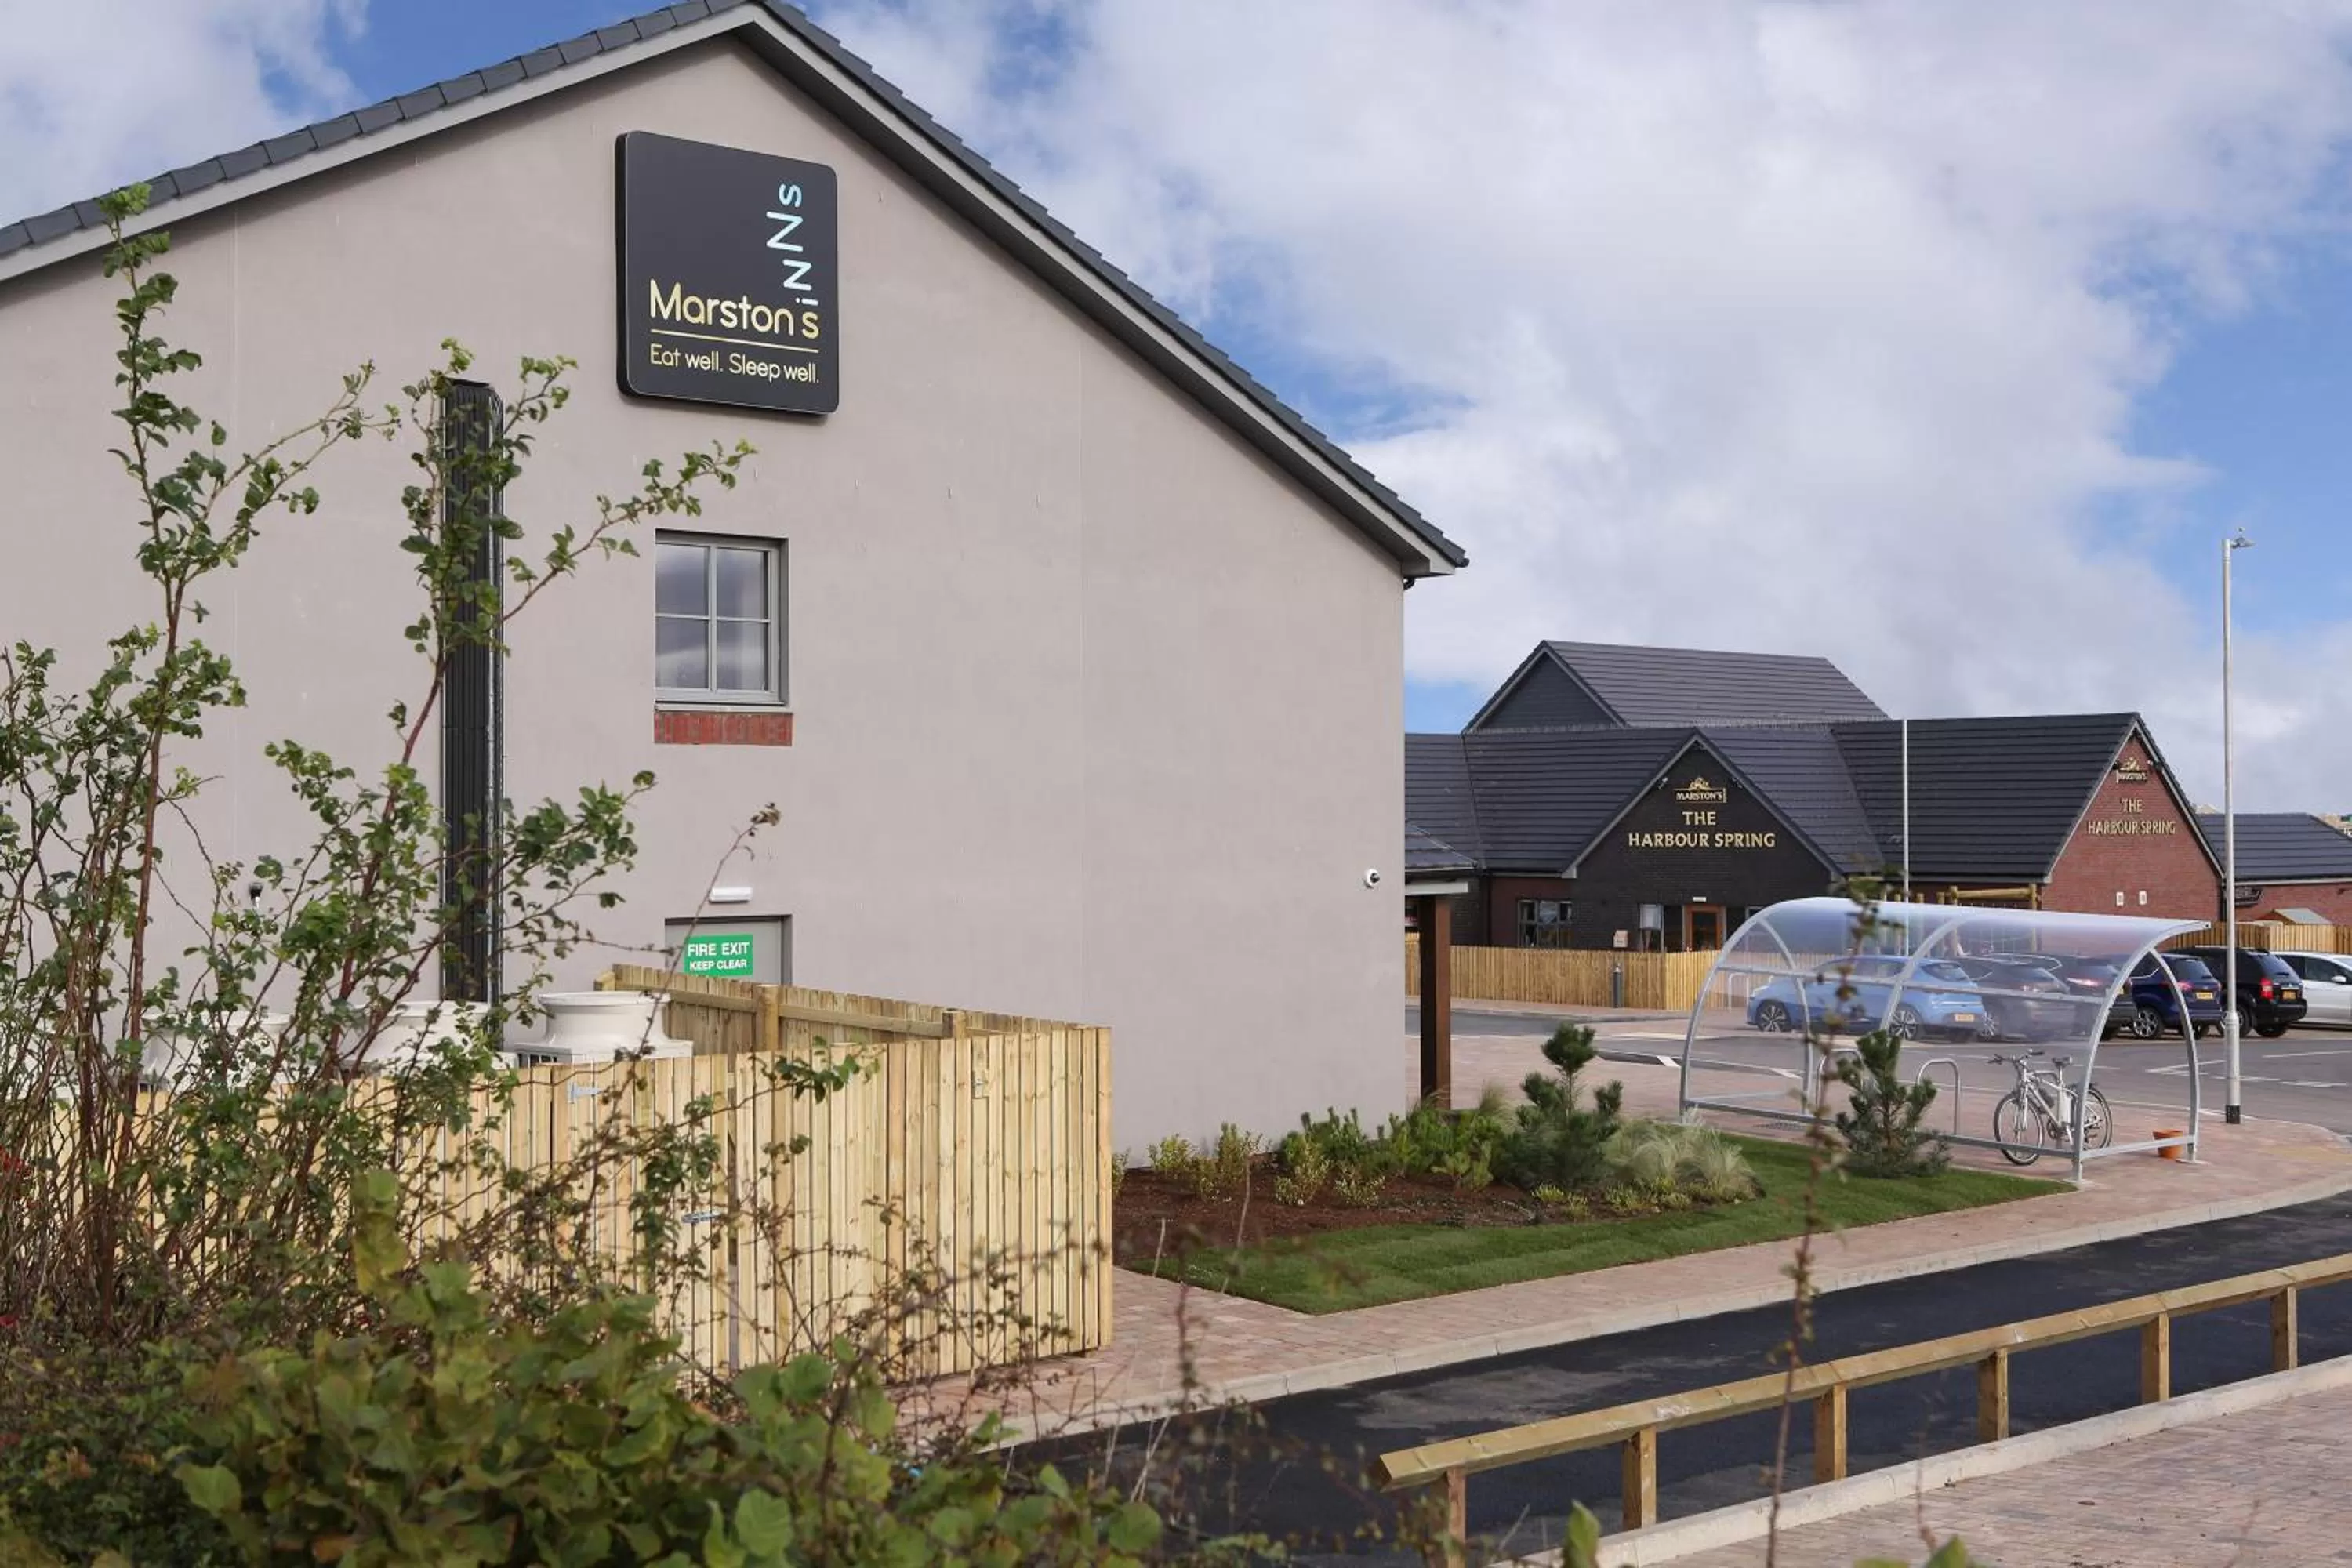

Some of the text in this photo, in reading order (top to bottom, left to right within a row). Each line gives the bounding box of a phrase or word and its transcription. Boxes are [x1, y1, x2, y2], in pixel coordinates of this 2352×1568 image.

[650, 343, 820, 383] Eat well. Sleep well.
[2121, 798, 2143, 813] THE
[1682, 811, 1717, 826] THE
[2088, 821, 2176, 835] HARBOUR SPRING
[1628, 833, 1777, 848] HARBOUR SPRING
[688, 942, 750, 956] FIRE EXIT
[689, 959, 747, 971] KEEP CLEAR
